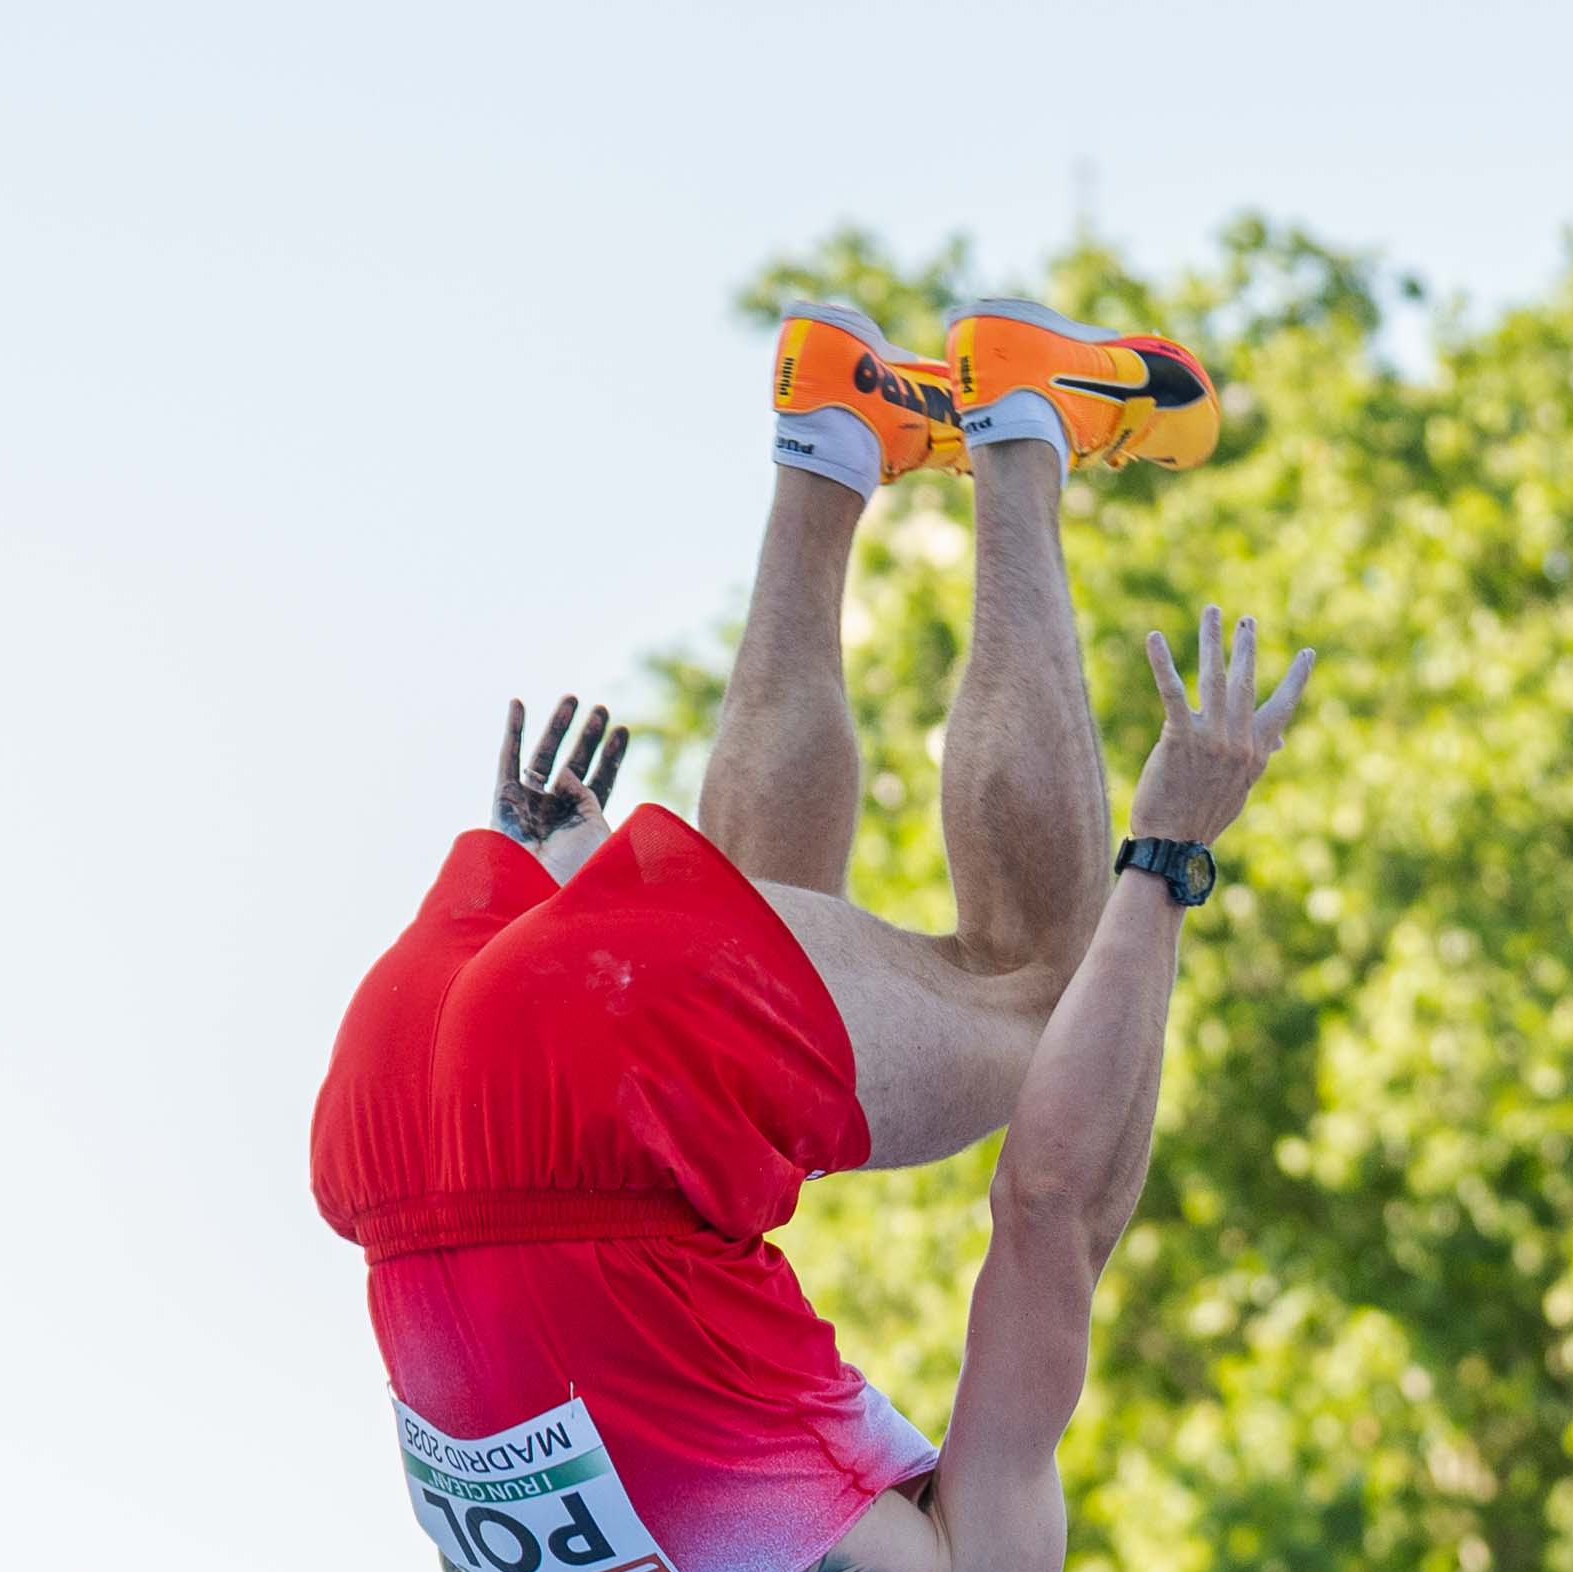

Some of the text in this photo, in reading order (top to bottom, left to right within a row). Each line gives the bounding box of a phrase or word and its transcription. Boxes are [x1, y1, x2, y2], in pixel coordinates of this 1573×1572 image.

[405, 1418, 573, 1473] MADRID 2025
[431, 1470, 483, 1500] CLEAN
[485, 1476, 538, 1500] RUN
